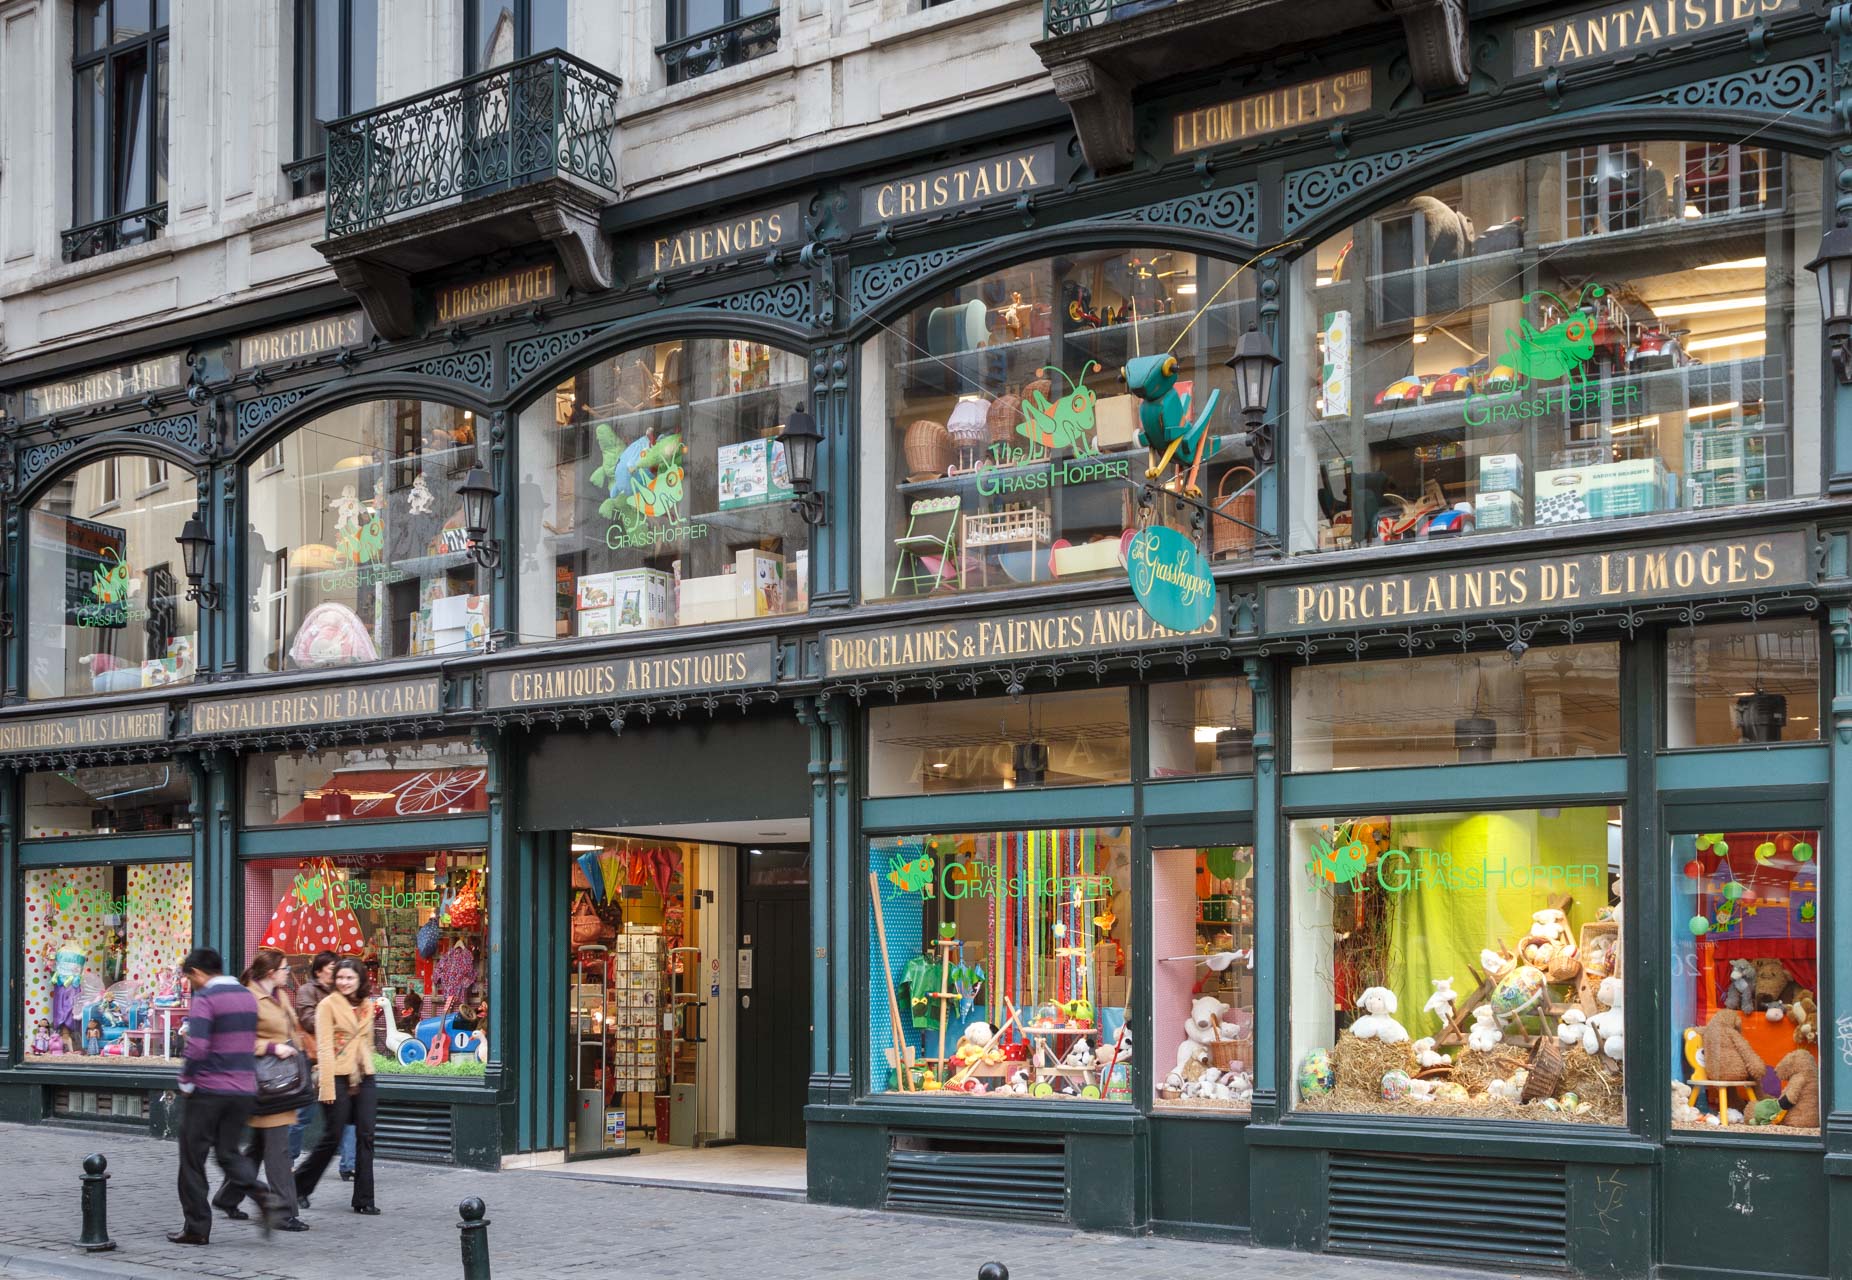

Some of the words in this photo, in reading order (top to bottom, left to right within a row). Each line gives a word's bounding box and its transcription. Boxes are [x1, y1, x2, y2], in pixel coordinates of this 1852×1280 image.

[1534, 0, 1782, 68] FANTAISIE
[1241, 81, 1326, 136] FOLLET
[877, 154, 1038, 218] CRISTAUX
[654, 214, 782, 271] FAÏENCES
[453, 266, 552, 318] ROSSUM-VOET
[248, 318, 357, 365] PORCELAINES
[44, 375, 113, 411] VERRERIES
[988, 442, 1023, 461] The
[976, 460, 1129, 496] GRASSHOPPER
[606, 523, 708, 550] GRASSHOPPER
[612, 508, 631, 527] The
[1136, 532, 1211, 606] Grasshopper
[1297, 567, 1528, 625] PORCELAINES
[1540, 562, 1581, 601] DE
[1600, 541, 1776, 595] LIMOGES
[831, 629, 959, 671] PORCELAINES
[962, 635, 976, 657] &
[979, 619, 1085, 656] FAÏENCES
[1090, 605, 1217, 645] ANGLS
[511, 666, 615, 702] CERAMIQUES
[626, 652, 747, 691] ARTISTIQUES
[79, 717, 97, 742] VAL
[112, 712, 163, 740] LAMBERT
[195, 696, 319, 731] CRISTALLERIES
[323, 693, 342, 720] DE
[347, 684, 437, 717] BACCARAT
[971, 861, 999, 878] The
[1377, 849, 1600, 892] GRASSHOPPER
[1414, 848, 1452, 866] The
[328, 880, 440, 911] GRASSHOPPER
[348, 879, 367, 893] The
[941, 862, 1113, 900] GRASSHOPPER
